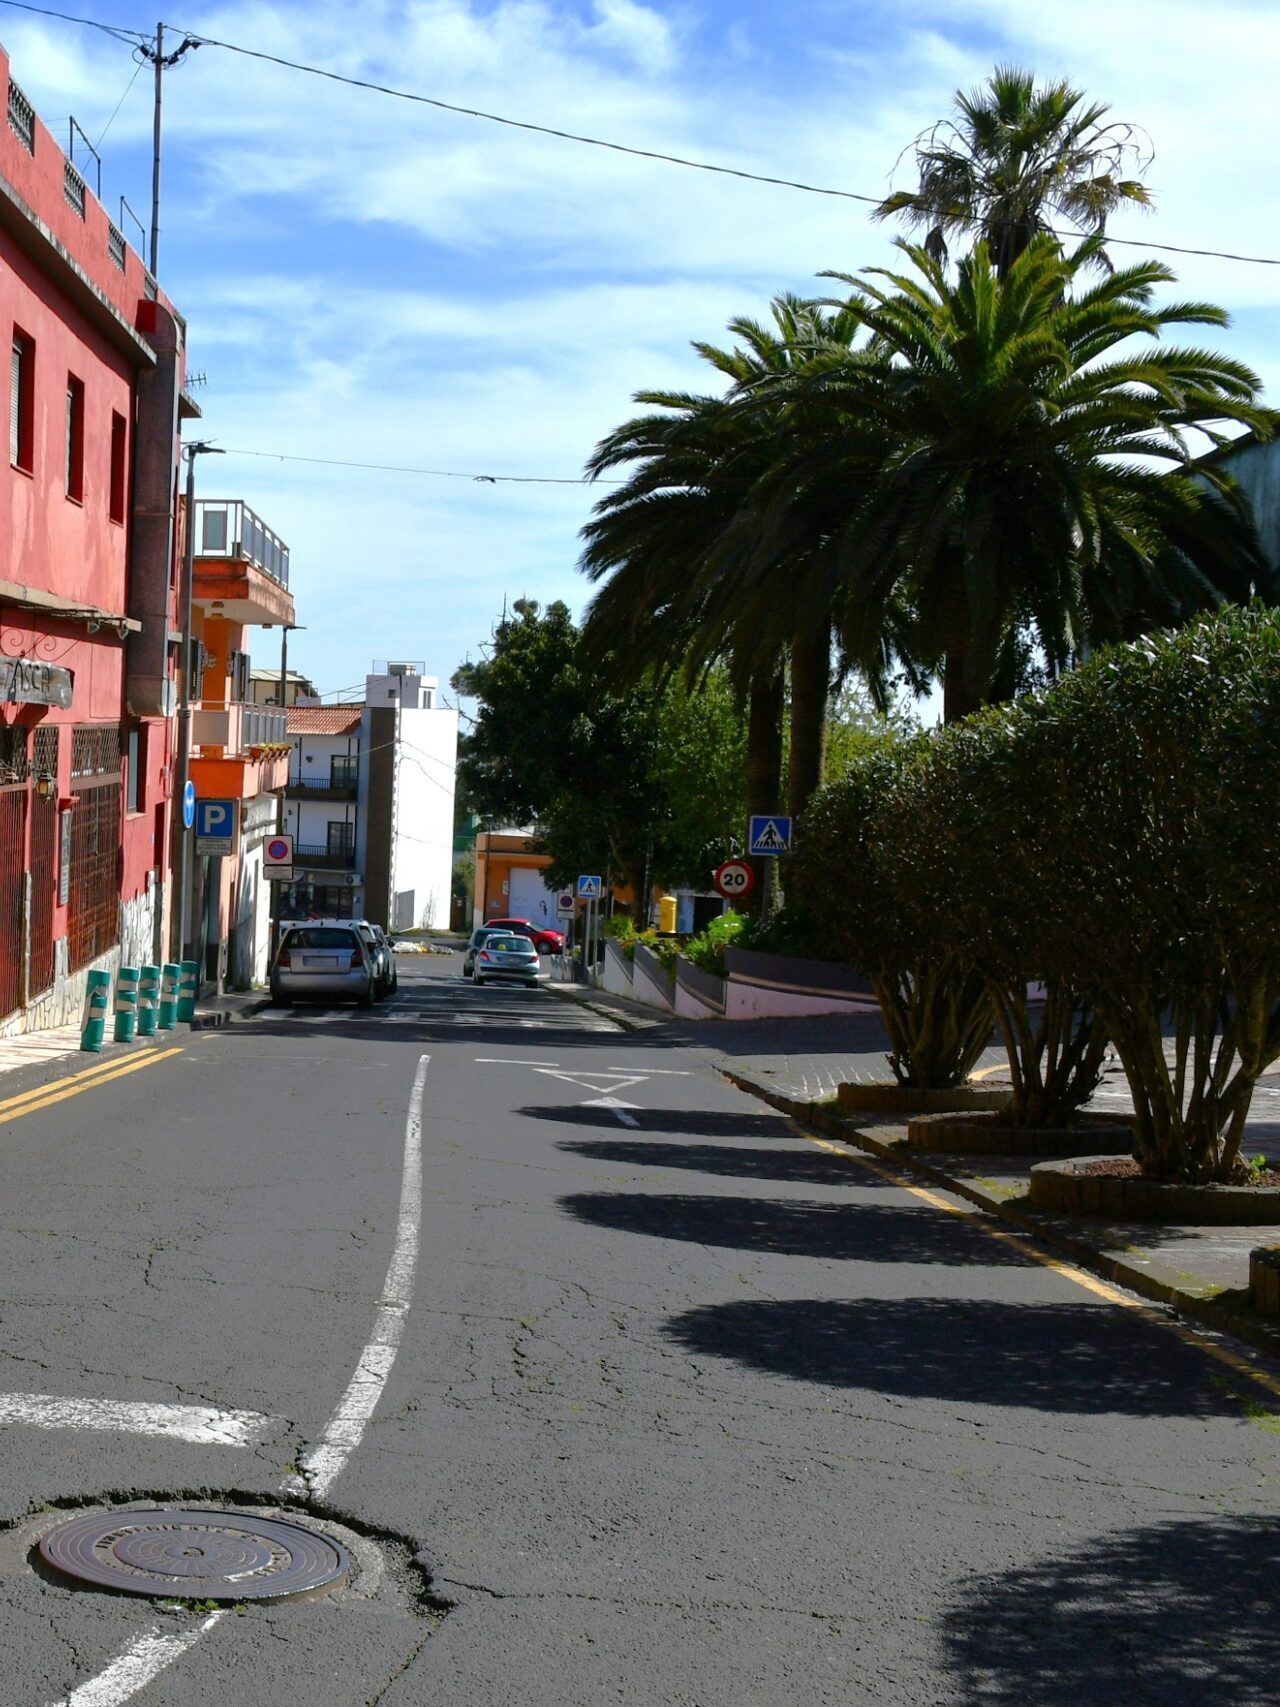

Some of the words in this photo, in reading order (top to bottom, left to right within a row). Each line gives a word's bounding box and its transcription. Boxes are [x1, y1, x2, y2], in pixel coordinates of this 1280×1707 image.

[1, 660, 51, 693] TASCA
[204, 805, 226, 833] P
[723, 873, 745, 886] 20
